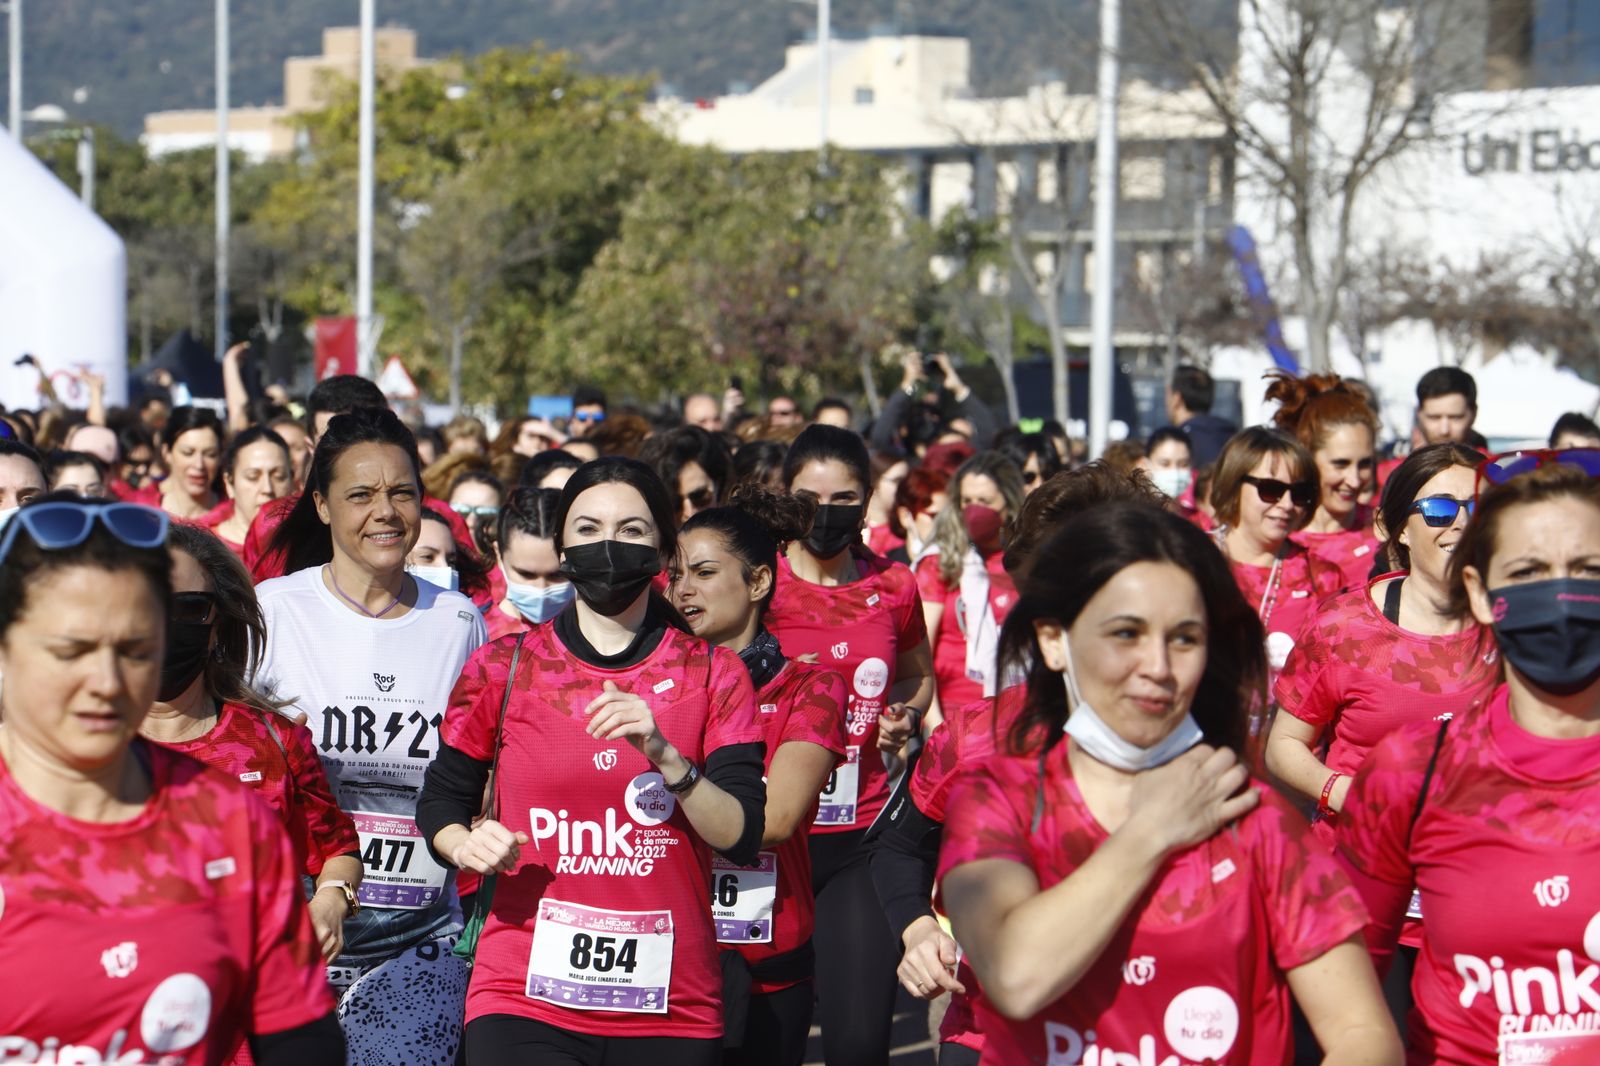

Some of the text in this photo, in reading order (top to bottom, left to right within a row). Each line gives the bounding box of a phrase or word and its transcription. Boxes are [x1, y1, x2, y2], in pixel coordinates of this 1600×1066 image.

[373, 673, 396, 685] Rock
[636, 800, 666, 811] tu día
[530, 807, 634, 858] Pink
[643, 836, 654, 844] de
[362, 838, 415, 873] 477
[635, 846, 666, 858] 2022
[556, 855, 654, 877] RUNNING
[570, 933, 638, 973] 854
[1453, 948, 1600, 1015] Pink
[1181, 1027, 1223, 1040] tu día
